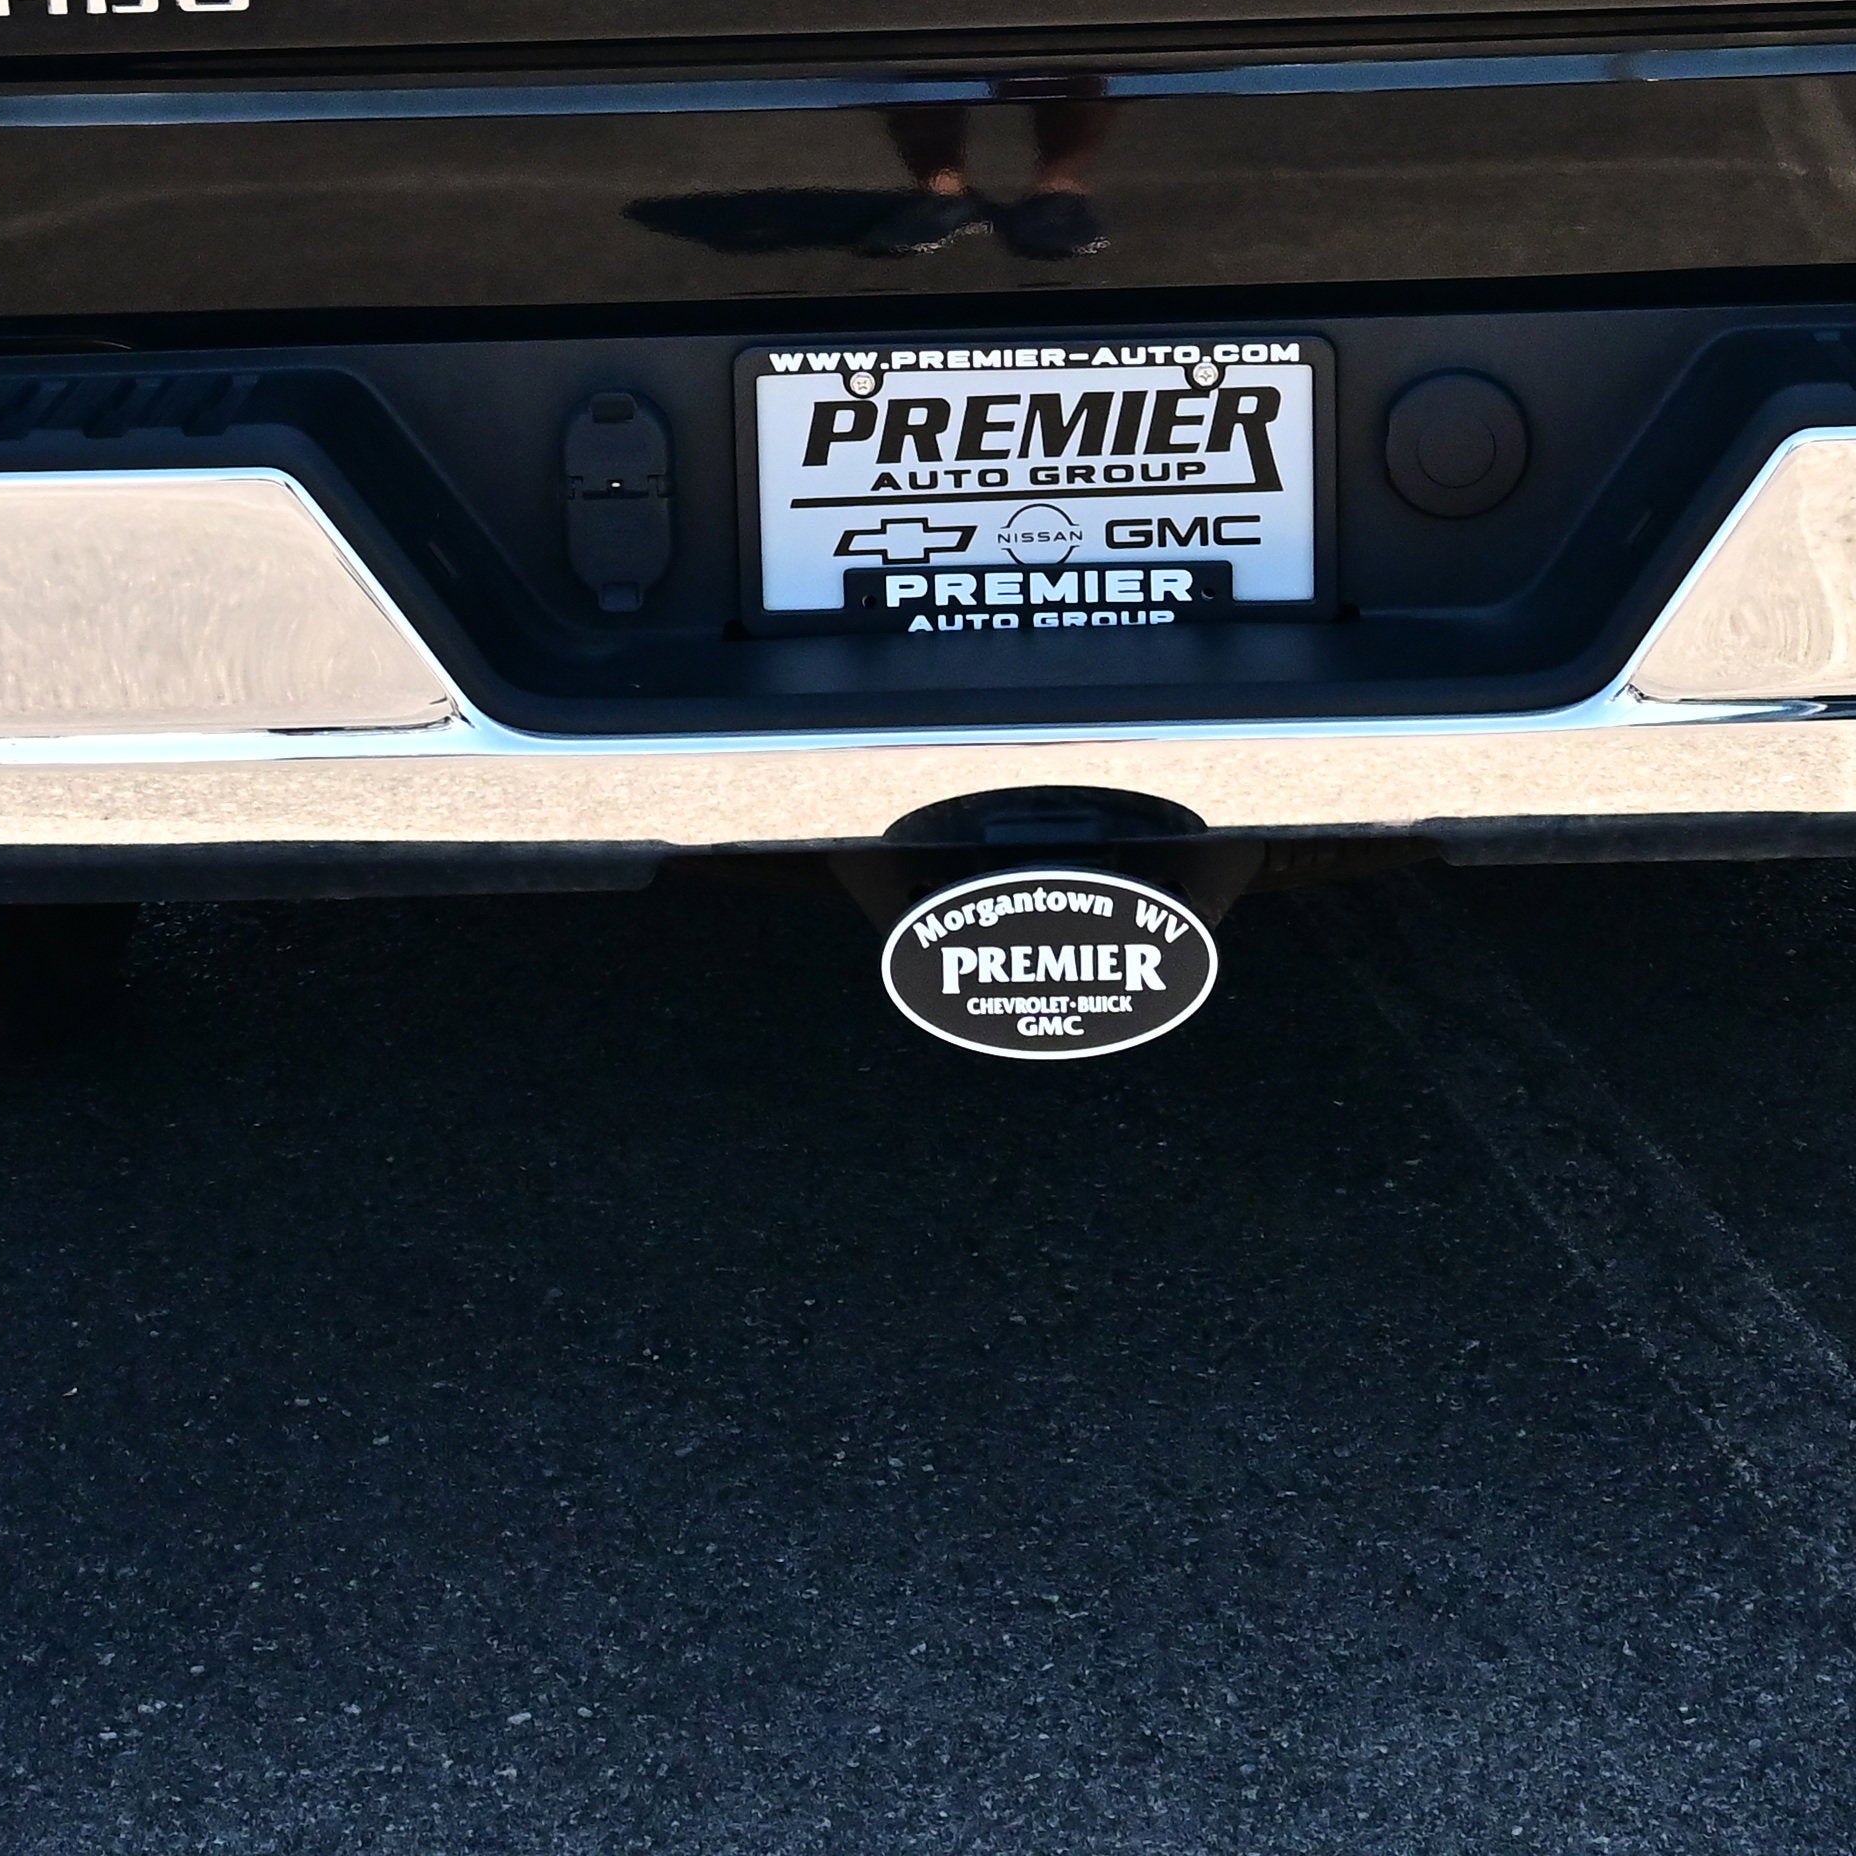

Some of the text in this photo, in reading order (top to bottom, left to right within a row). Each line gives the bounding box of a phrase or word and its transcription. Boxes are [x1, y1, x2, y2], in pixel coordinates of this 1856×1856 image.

[769, 343, 1301, 373] WWW.PREMIER-AUTO.COM
[802, 385, 1284, 492] PREMIER
[870, 461, 1208, 492] AUTO GROUP
[997, 529, 1084, 545] NISSAN
[1104, 515, 1262, 551] GMC
[884, 568, 1194, 609] PREMIER
[907, 609, 1176, 633] AUTO GROUP
[912, 886, 1190, 950] Morgantown WV
[940, 943, 1167, 995] PREMIER
[1077, 994, 1133, 1013] BUICK
[1016, 1015, 1085, 1037] GMC
